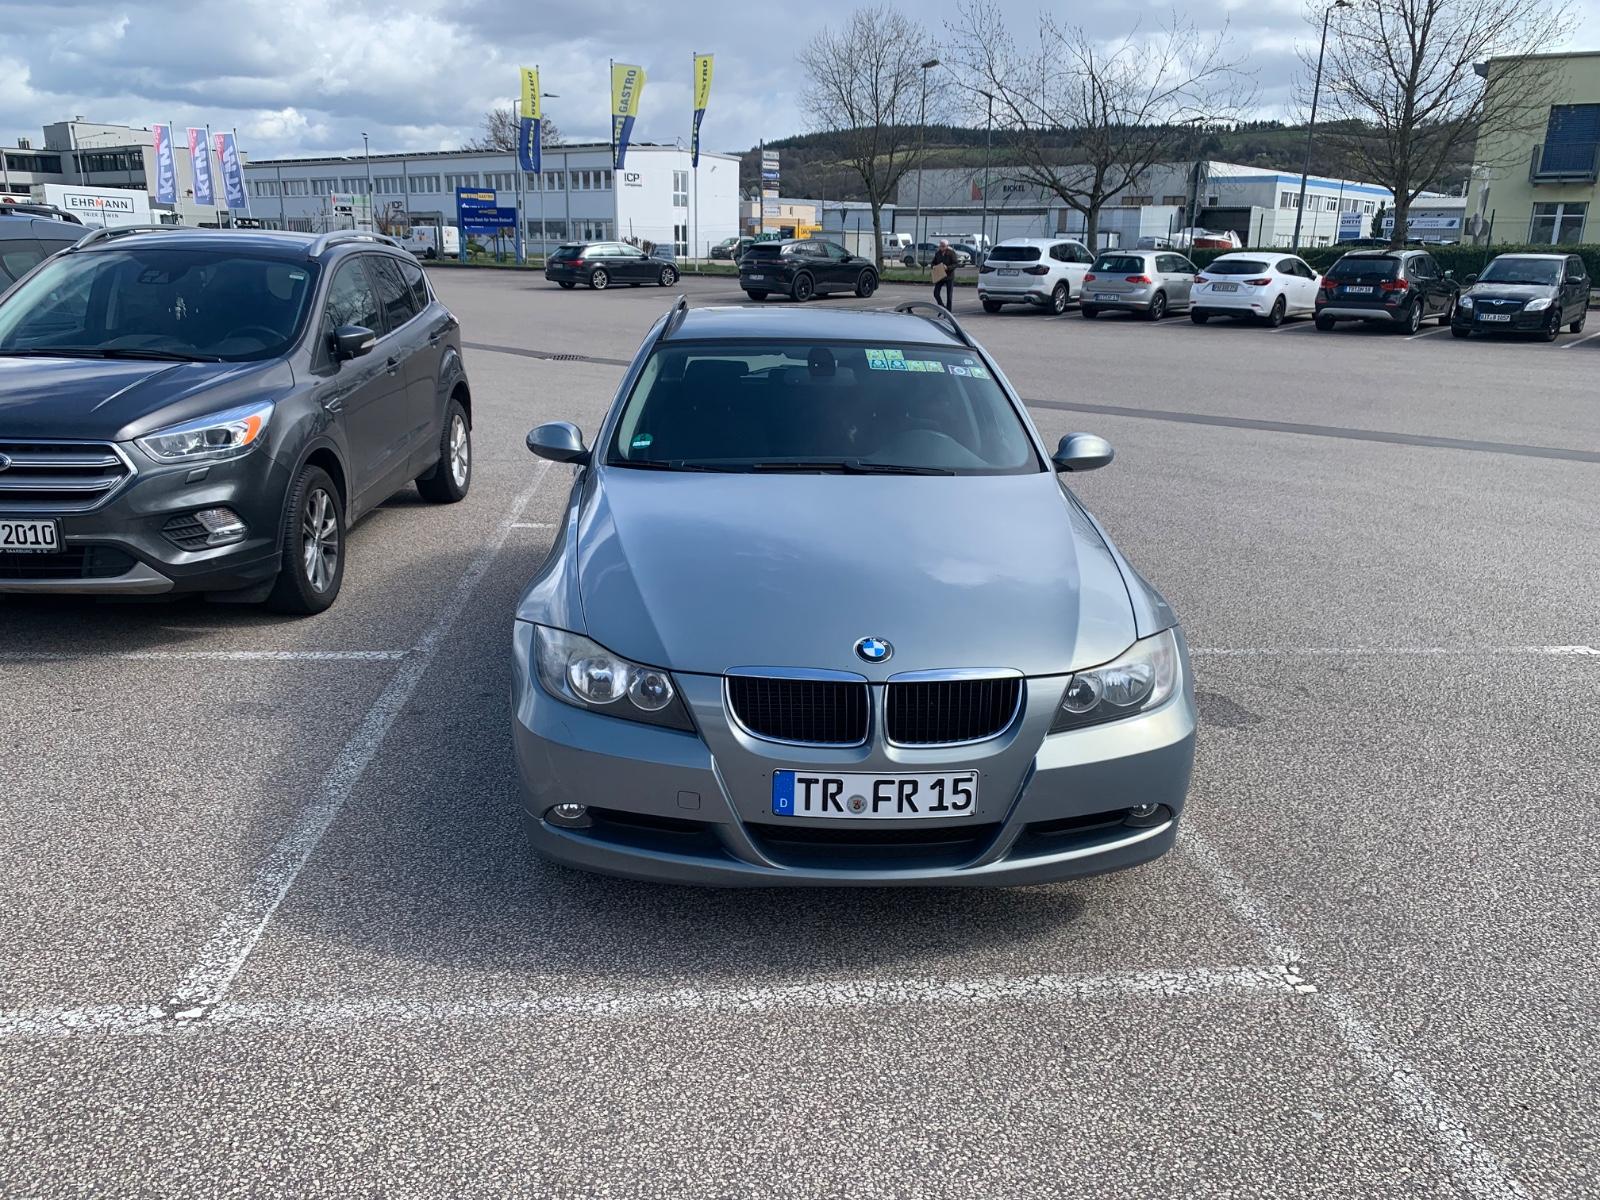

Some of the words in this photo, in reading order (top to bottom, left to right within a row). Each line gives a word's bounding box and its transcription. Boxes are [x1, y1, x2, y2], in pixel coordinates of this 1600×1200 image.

[618, 69, 637, 113] GASTRO
[624, 172, 640, 182] ICP
[71, 197, 129, 209] EHRMANN
[1, 524, 55, 545] 2010
[797, 778, 844, 812] TR
[872, 779, 919, 812] FR
[929, 777, 973, 811] 15
[780, 798, 788, 808] D
